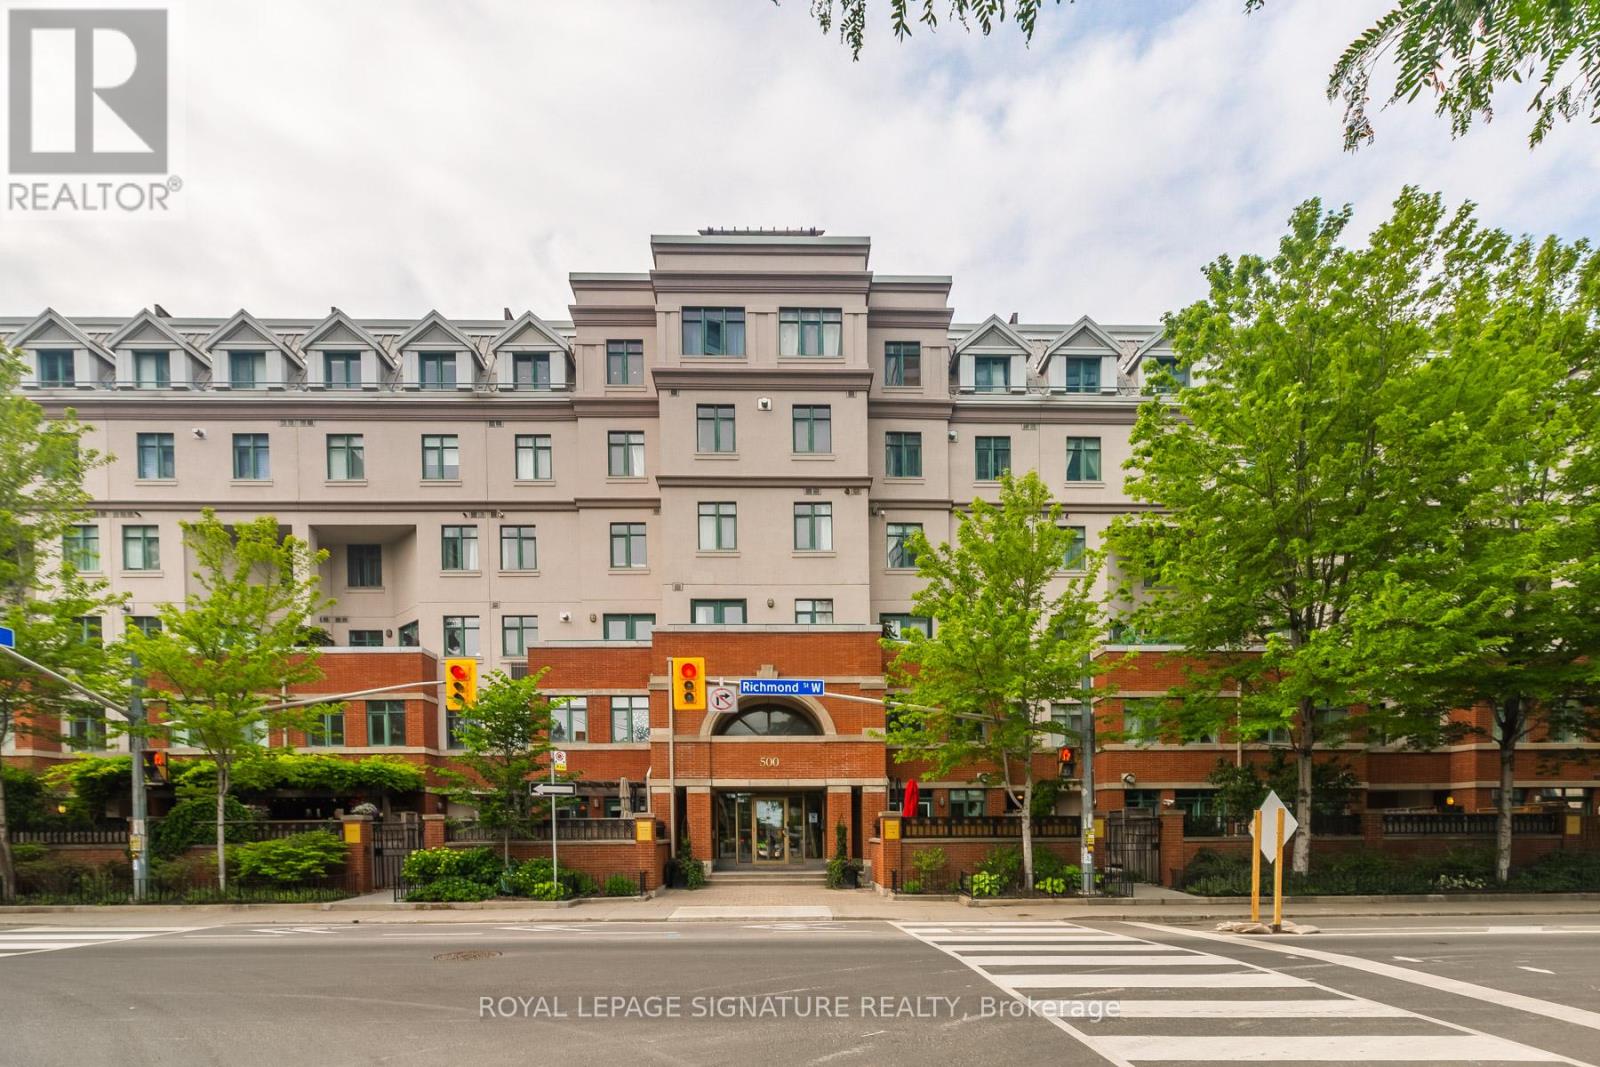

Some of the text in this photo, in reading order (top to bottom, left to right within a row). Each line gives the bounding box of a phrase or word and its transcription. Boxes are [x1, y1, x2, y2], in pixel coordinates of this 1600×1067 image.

[742, 682, 799, 693] Richmond
[811, 682, 822, 693] W
[759, 756, 780, 767] 500
